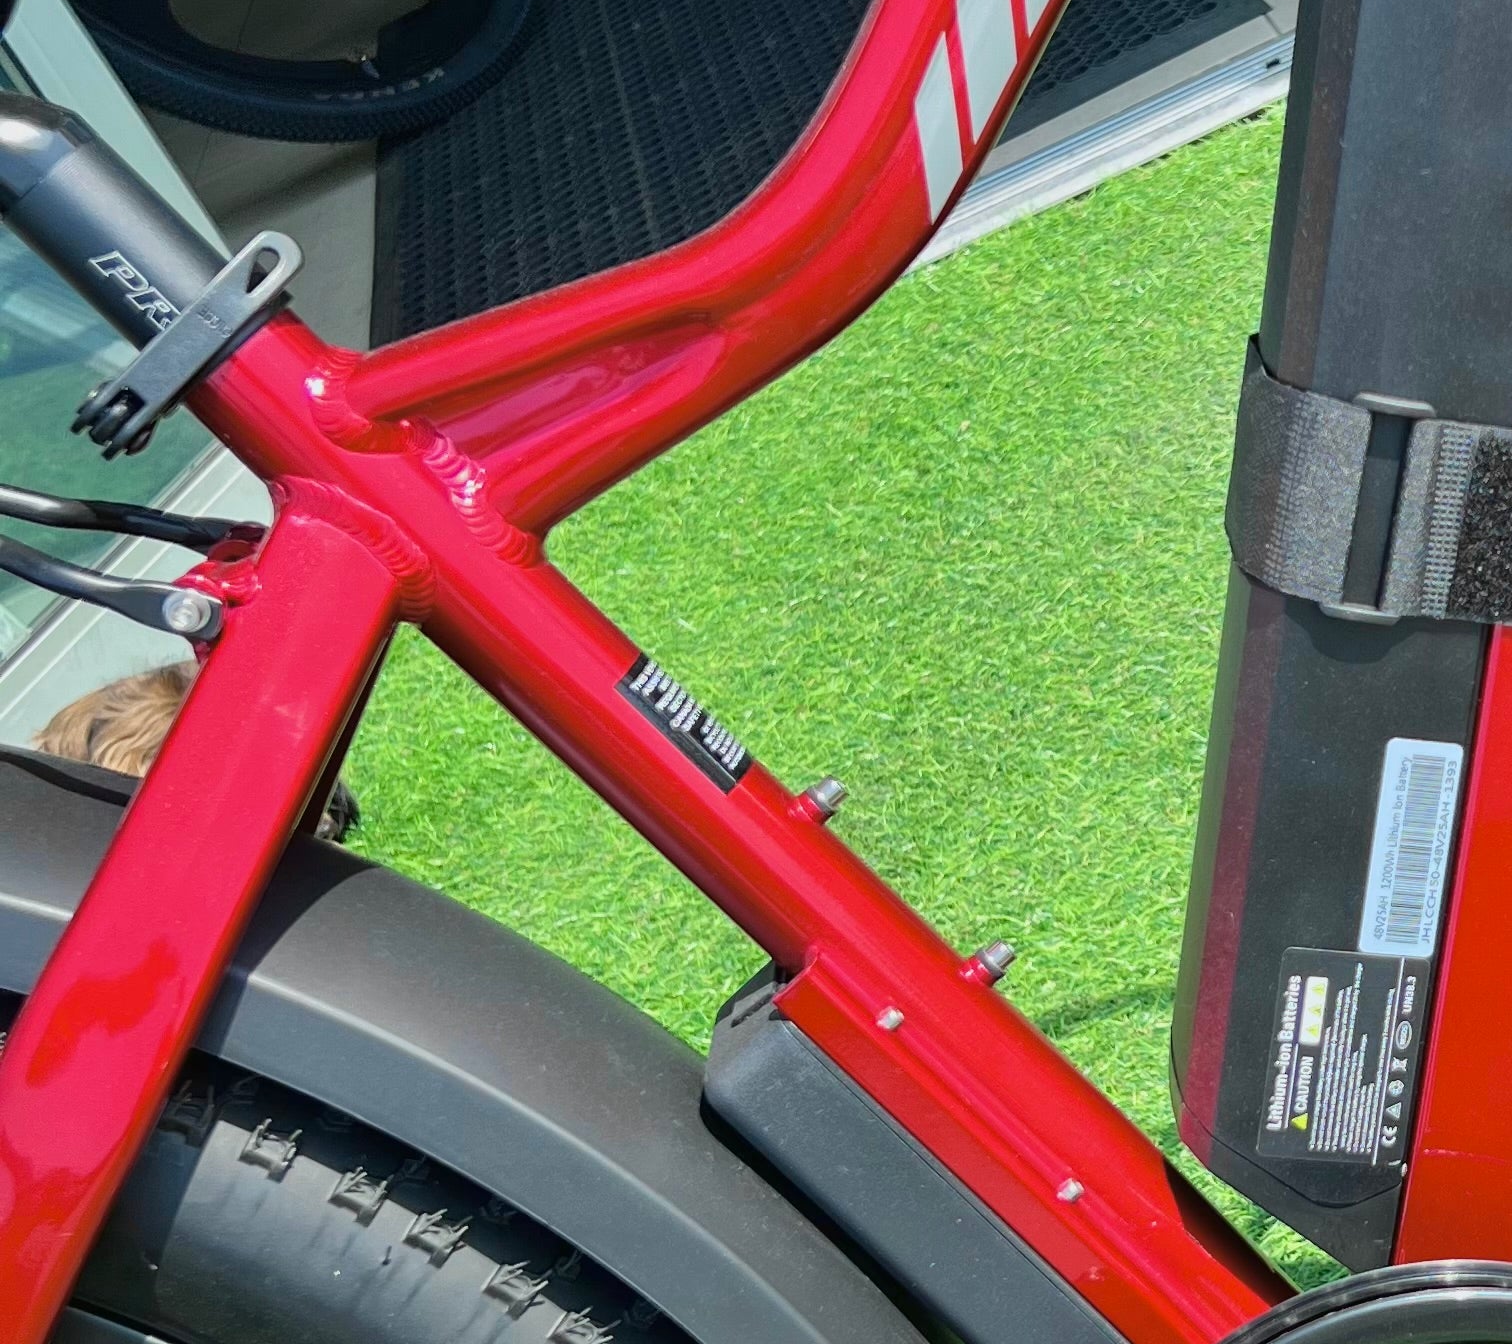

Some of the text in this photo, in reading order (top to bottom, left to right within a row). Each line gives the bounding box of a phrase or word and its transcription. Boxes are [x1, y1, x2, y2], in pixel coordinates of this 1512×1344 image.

[1396, 757, 1412, 793] Battery
[1266, 975, 1301, 1131] Lithium-ion Batteries
[1294, 1056, 1314, 1112] CAUTION
